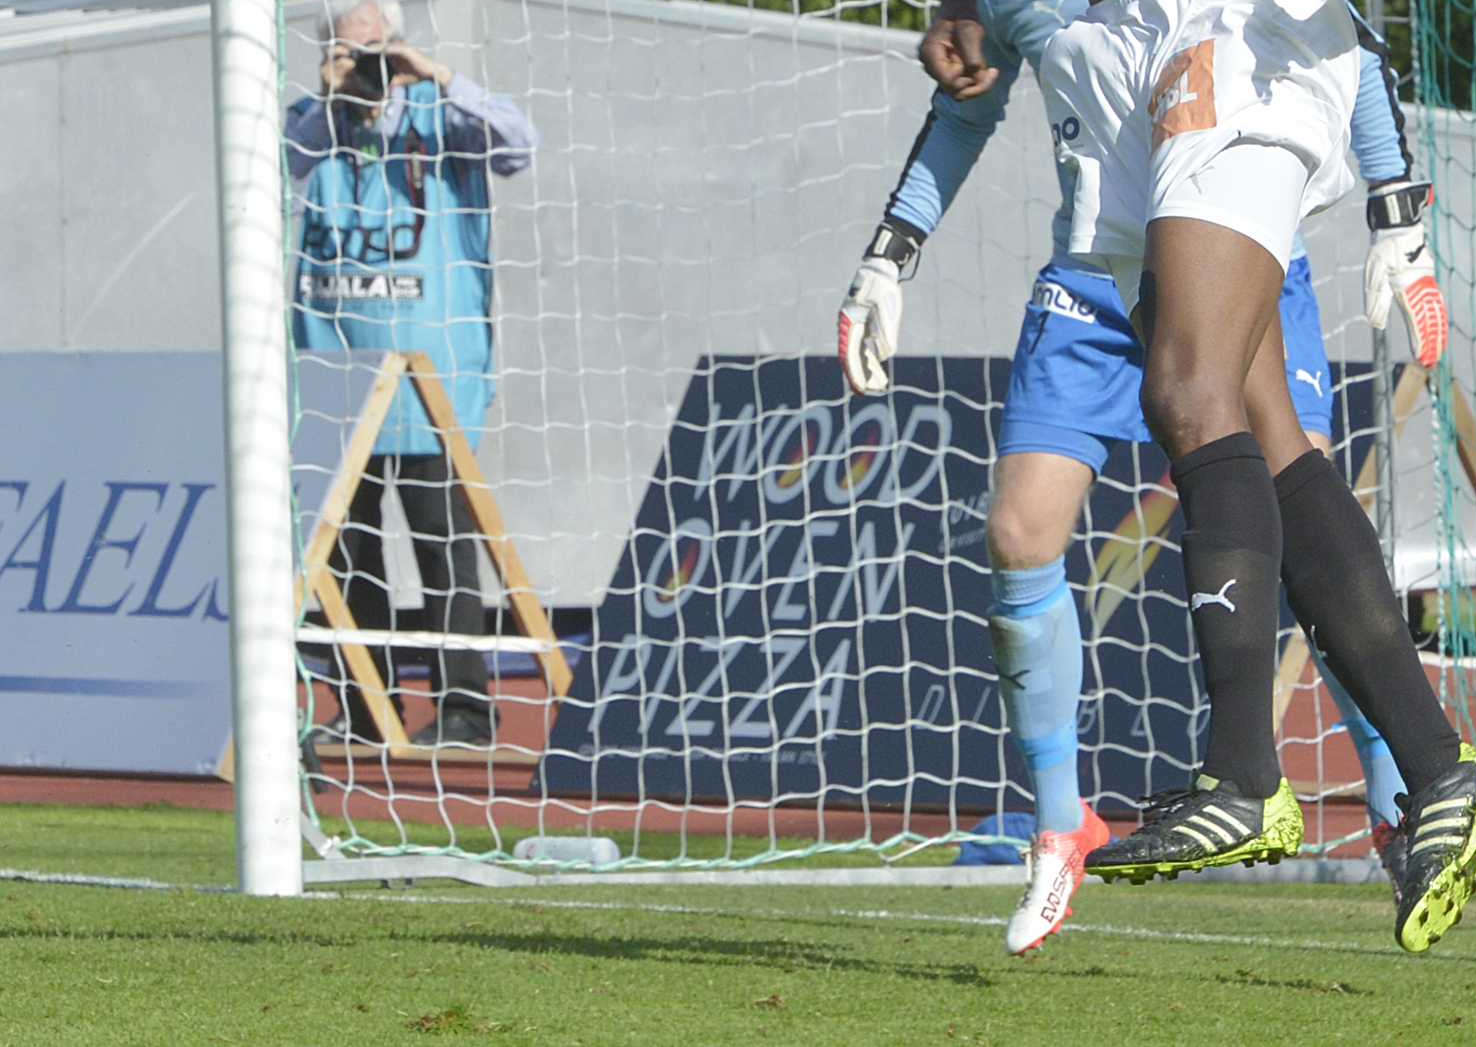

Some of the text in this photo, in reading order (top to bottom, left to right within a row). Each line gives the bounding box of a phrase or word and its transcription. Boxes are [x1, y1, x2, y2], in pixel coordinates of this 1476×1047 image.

[693, 402, 953, 504] WOOD
[0, 479, 230, 621] AEL
[643, 517, 916, 622] OVEN
[587, 634, 850, 740] PIZZA
[915, 683, 1211, 739] DIBLO
